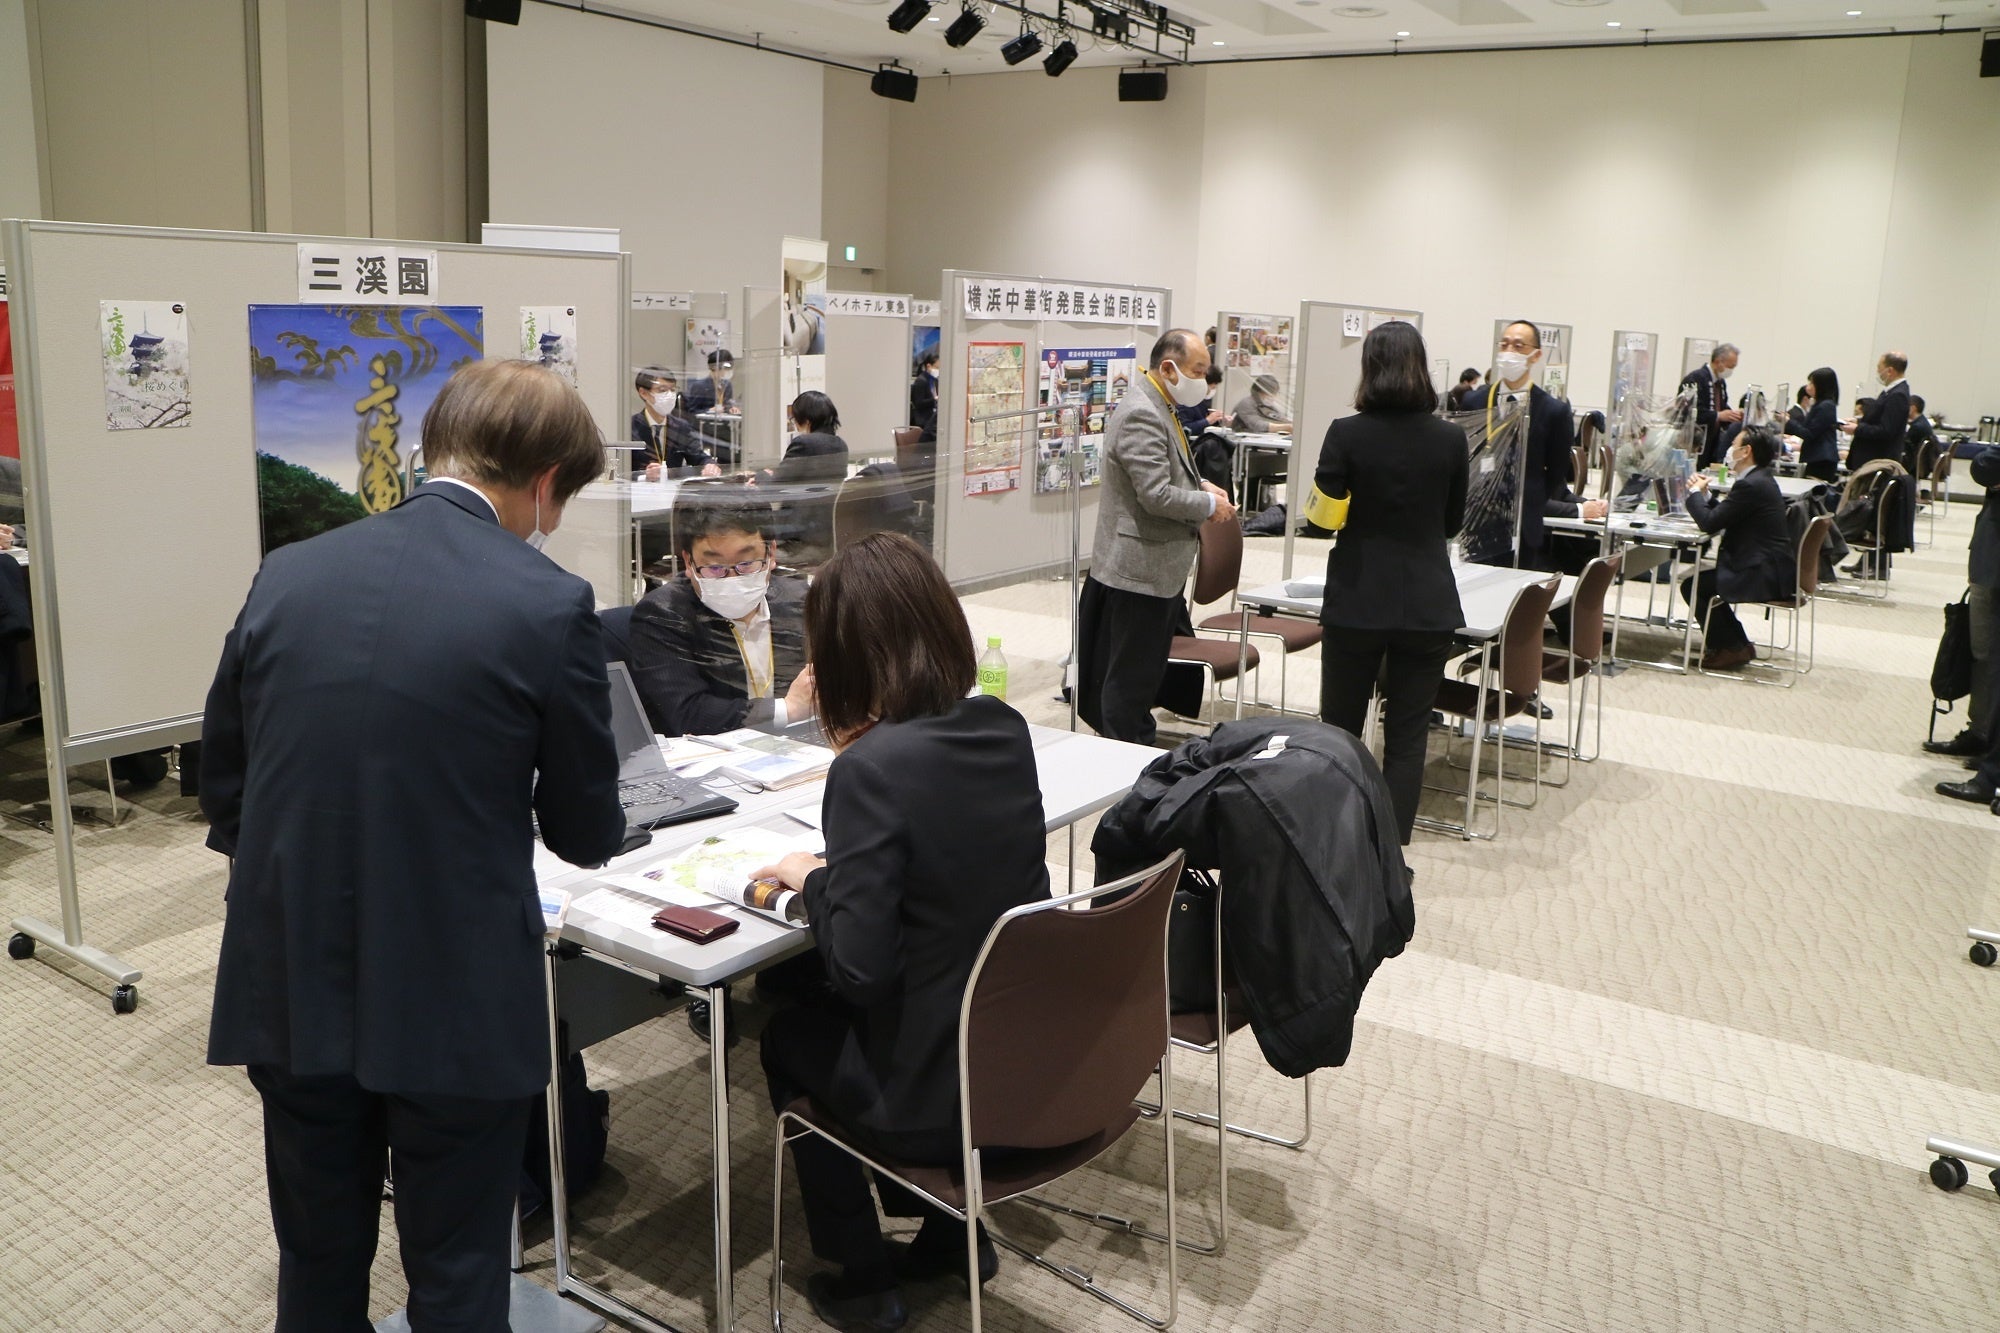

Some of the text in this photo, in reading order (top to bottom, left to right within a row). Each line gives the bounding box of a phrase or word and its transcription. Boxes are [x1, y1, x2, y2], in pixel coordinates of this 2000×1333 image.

[309, 256, 428, 295] 三溪園
[968, 285, 1156, 320] 横浜中華街発展会協同組合
